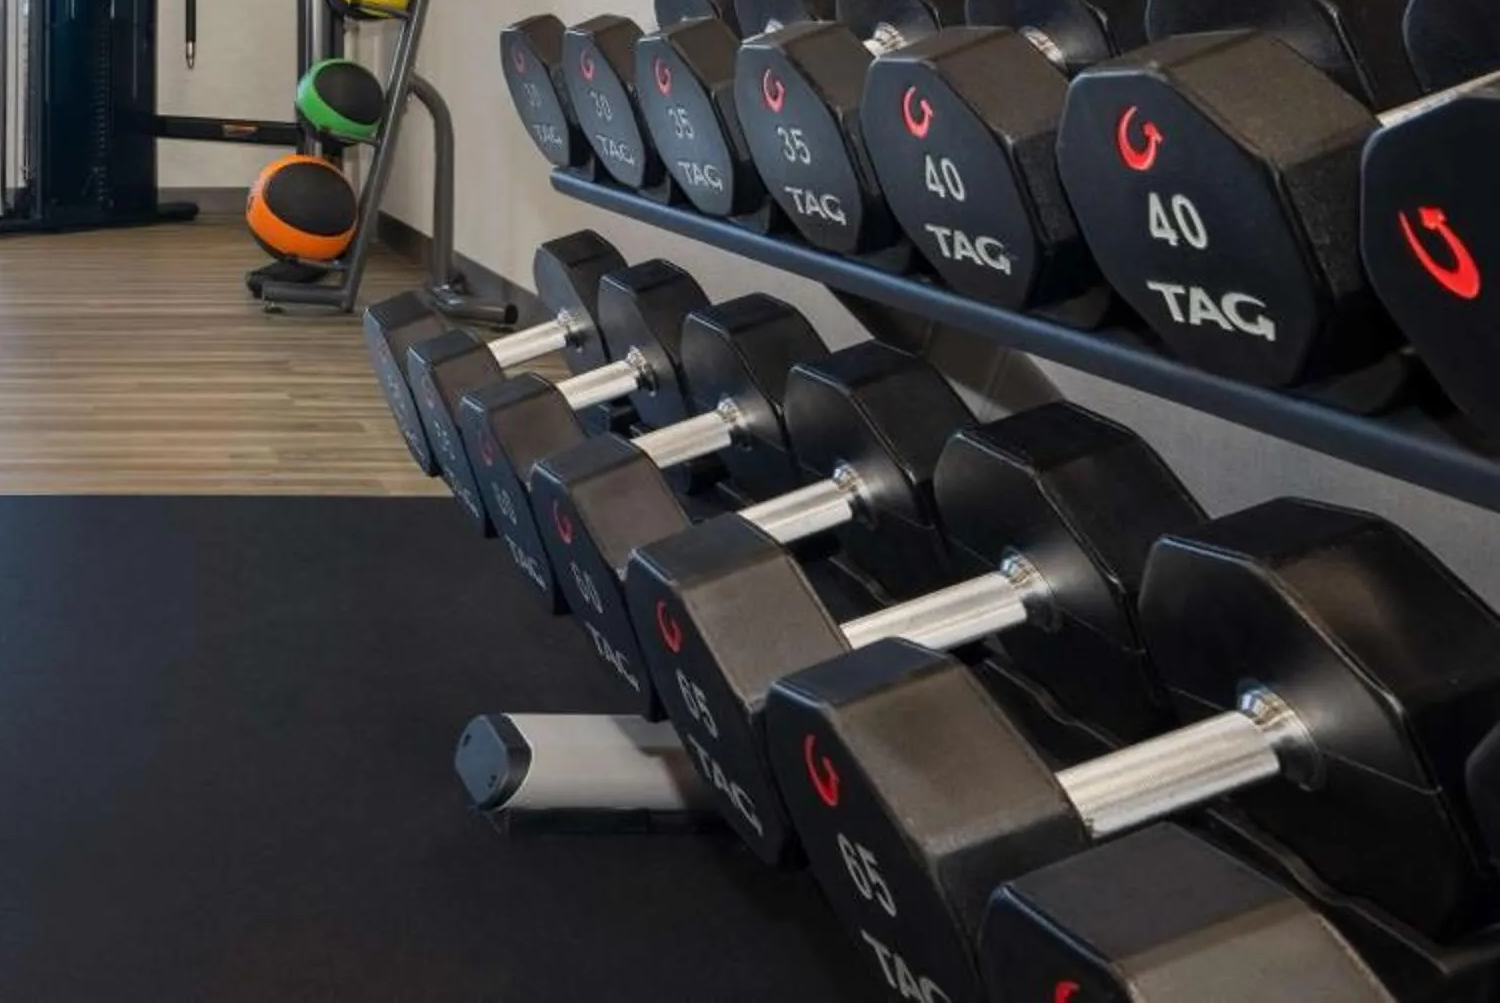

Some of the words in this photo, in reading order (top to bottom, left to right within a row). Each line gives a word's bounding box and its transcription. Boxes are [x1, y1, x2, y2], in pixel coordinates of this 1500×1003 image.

[667, 108, 696, 139] 35
[777, 125, 811, 165] 35
[596, 134, 636, 166] TAG
[677, 160, 724, 192] TAG
[925, 154, 966, 202] 40
[785, 185, 847, 226] TAG
[1148, 192, 1209, 249] 40
[925, 223, 1012, 275] TAG
[1146, 279, 1276, 342] TAG
[585, 619, 642, 693] TAG
[676, 669, 718, 739] 65
[687, 733, 764, 837] TAG
[838, 833, 897, 918] 65
